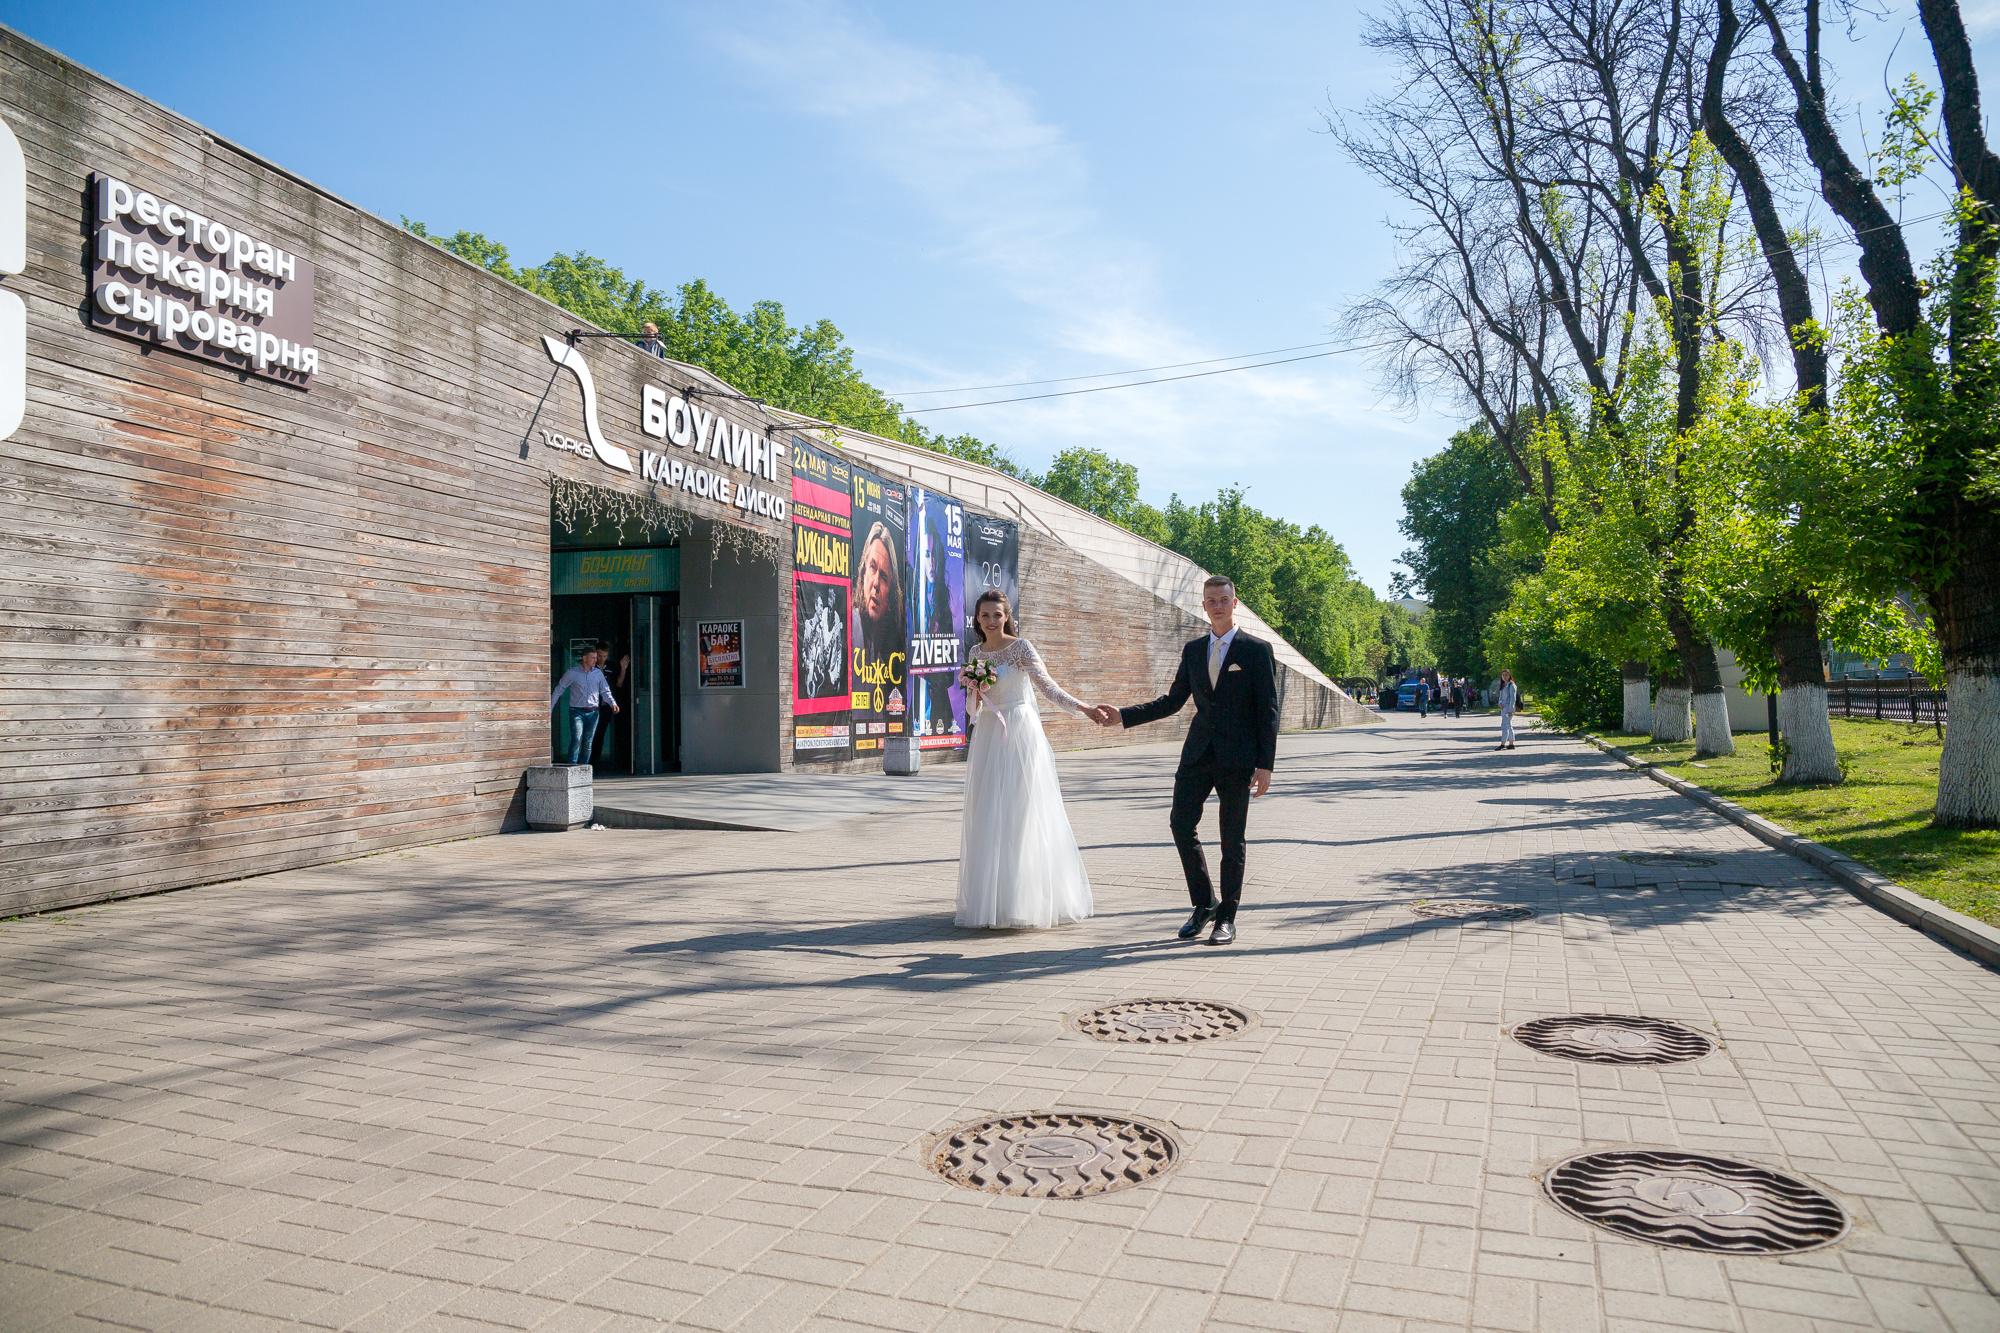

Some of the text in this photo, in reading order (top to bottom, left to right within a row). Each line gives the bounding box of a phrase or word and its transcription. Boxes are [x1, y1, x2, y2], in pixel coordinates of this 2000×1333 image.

[99, 177, 295, 282] ресторан
[99, 228, 274, 318] пекарня
[97, 281, 318, 375] сыроварня
[643, 383, 785, 482] БОУЛИНГ
[794, 446, 827, 475] 24 МАЯ
[642, 449, 785, 520] КАРАОКЕ ДИСКО
[853, 475, 865, 508] 15
[866, 480, 881, 499] ИЮНЯ
[794, 503, 850, 530] ЛЕГЕНДАРНАЯ ГРУППА
[944, 503, 962, 536] 15
[947, 535, 962, 549] МАЯ
[982, 561, 1002, 588] 20
[702, 623, 738, 634] КАРАОКЕ
[710, 634, 730, 646] БАР
[708, 654, 738, 664] БЕСПЛАТНО
[911, 638, 960, 665] ZIVERT
